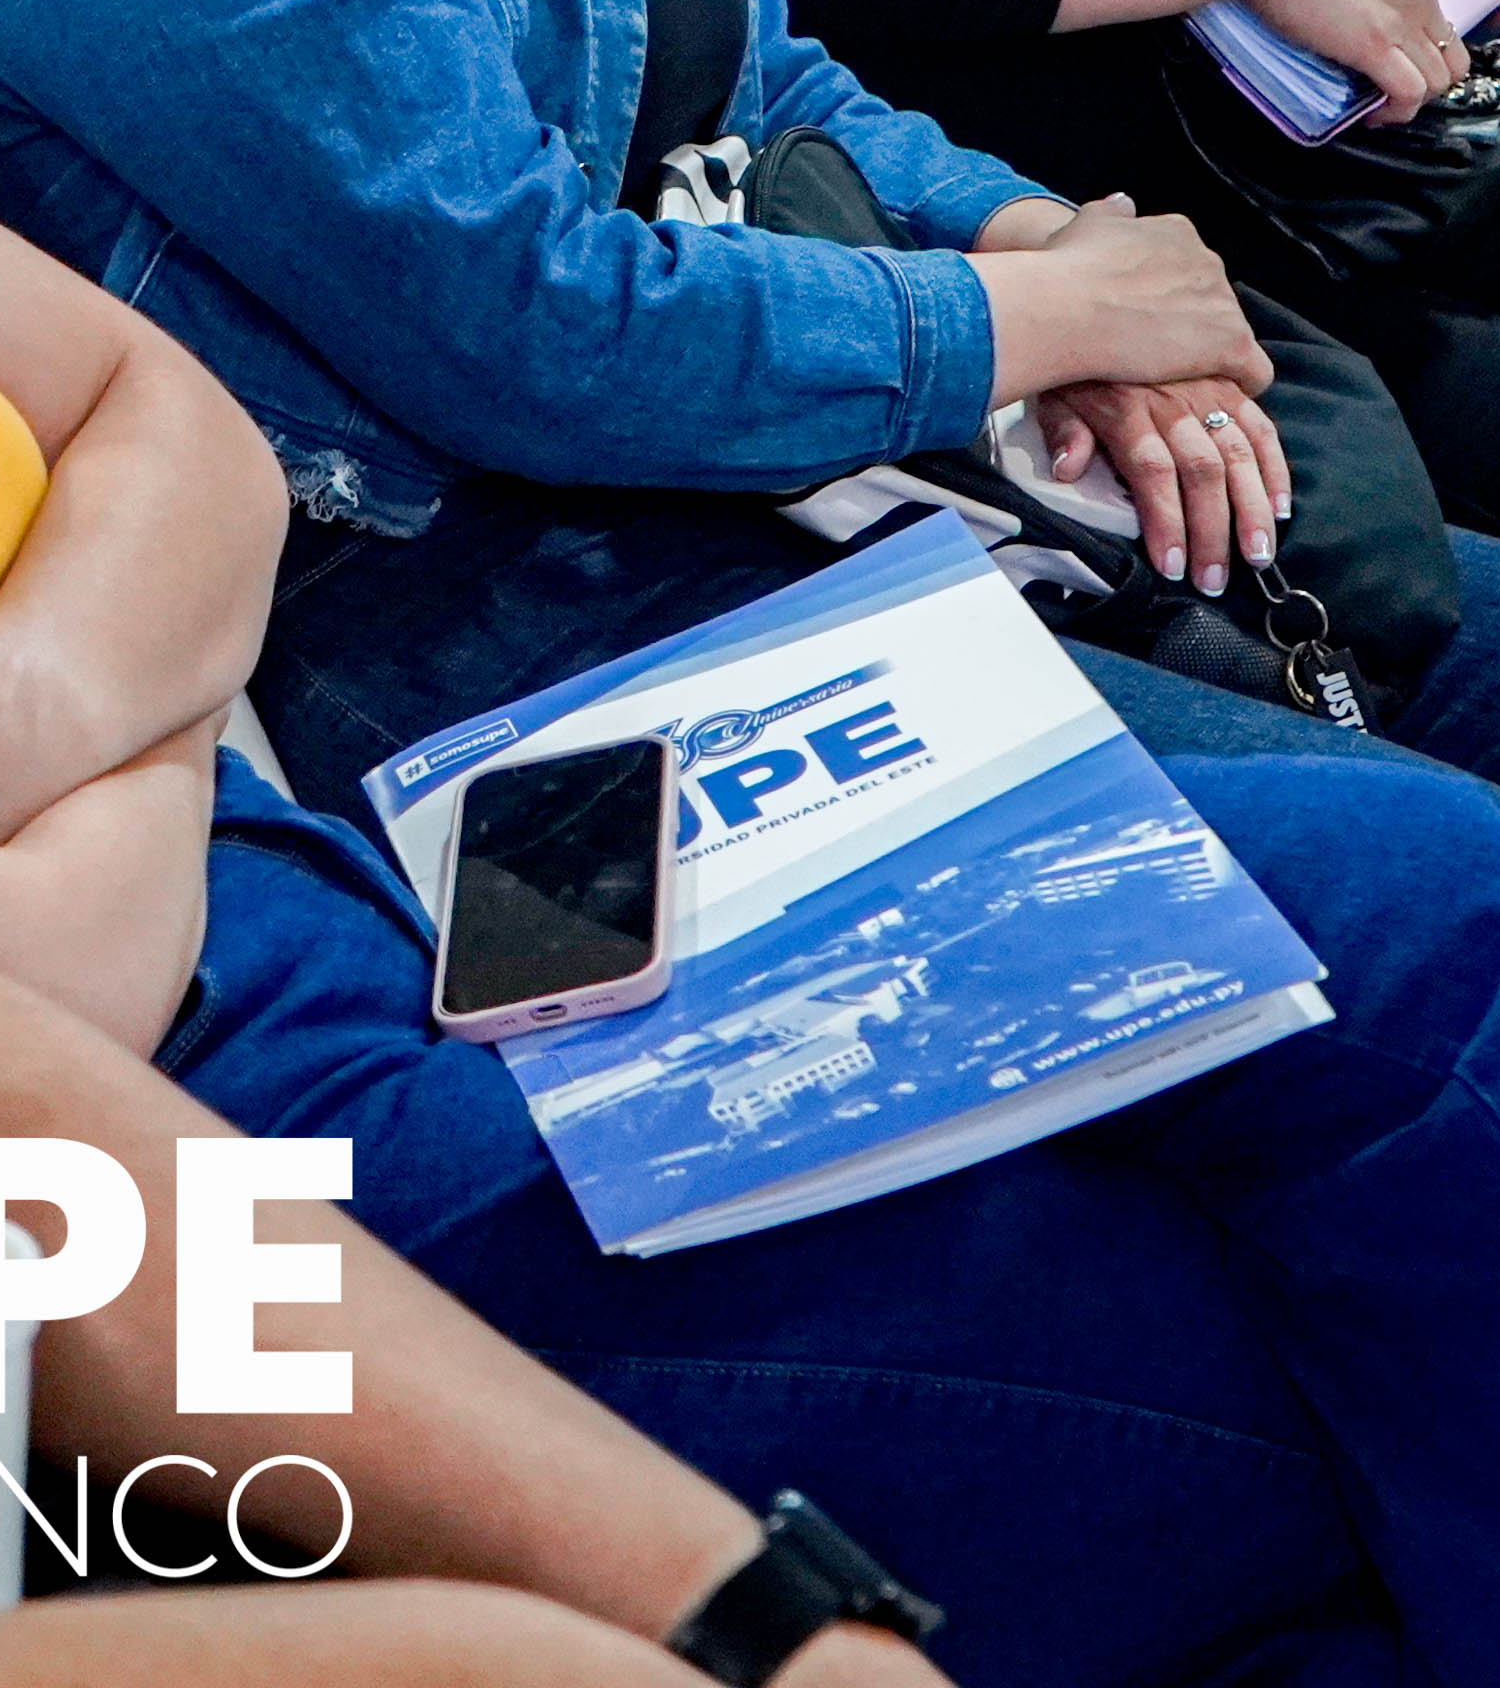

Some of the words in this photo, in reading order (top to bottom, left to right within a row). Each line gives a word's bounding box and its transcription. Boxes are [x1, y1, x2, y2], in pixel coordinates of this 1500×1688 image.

[1315, 671, 1365, 728] JUST
[677, 831, 751, 866] RSIDAD
[756, 795, 841, 835] PRIVADA
[845, 778, 884, 799] DEL
[888, 754, 939, 781] ESTE
[1033, 980, 1244, 1071] www.upe.edu.py
